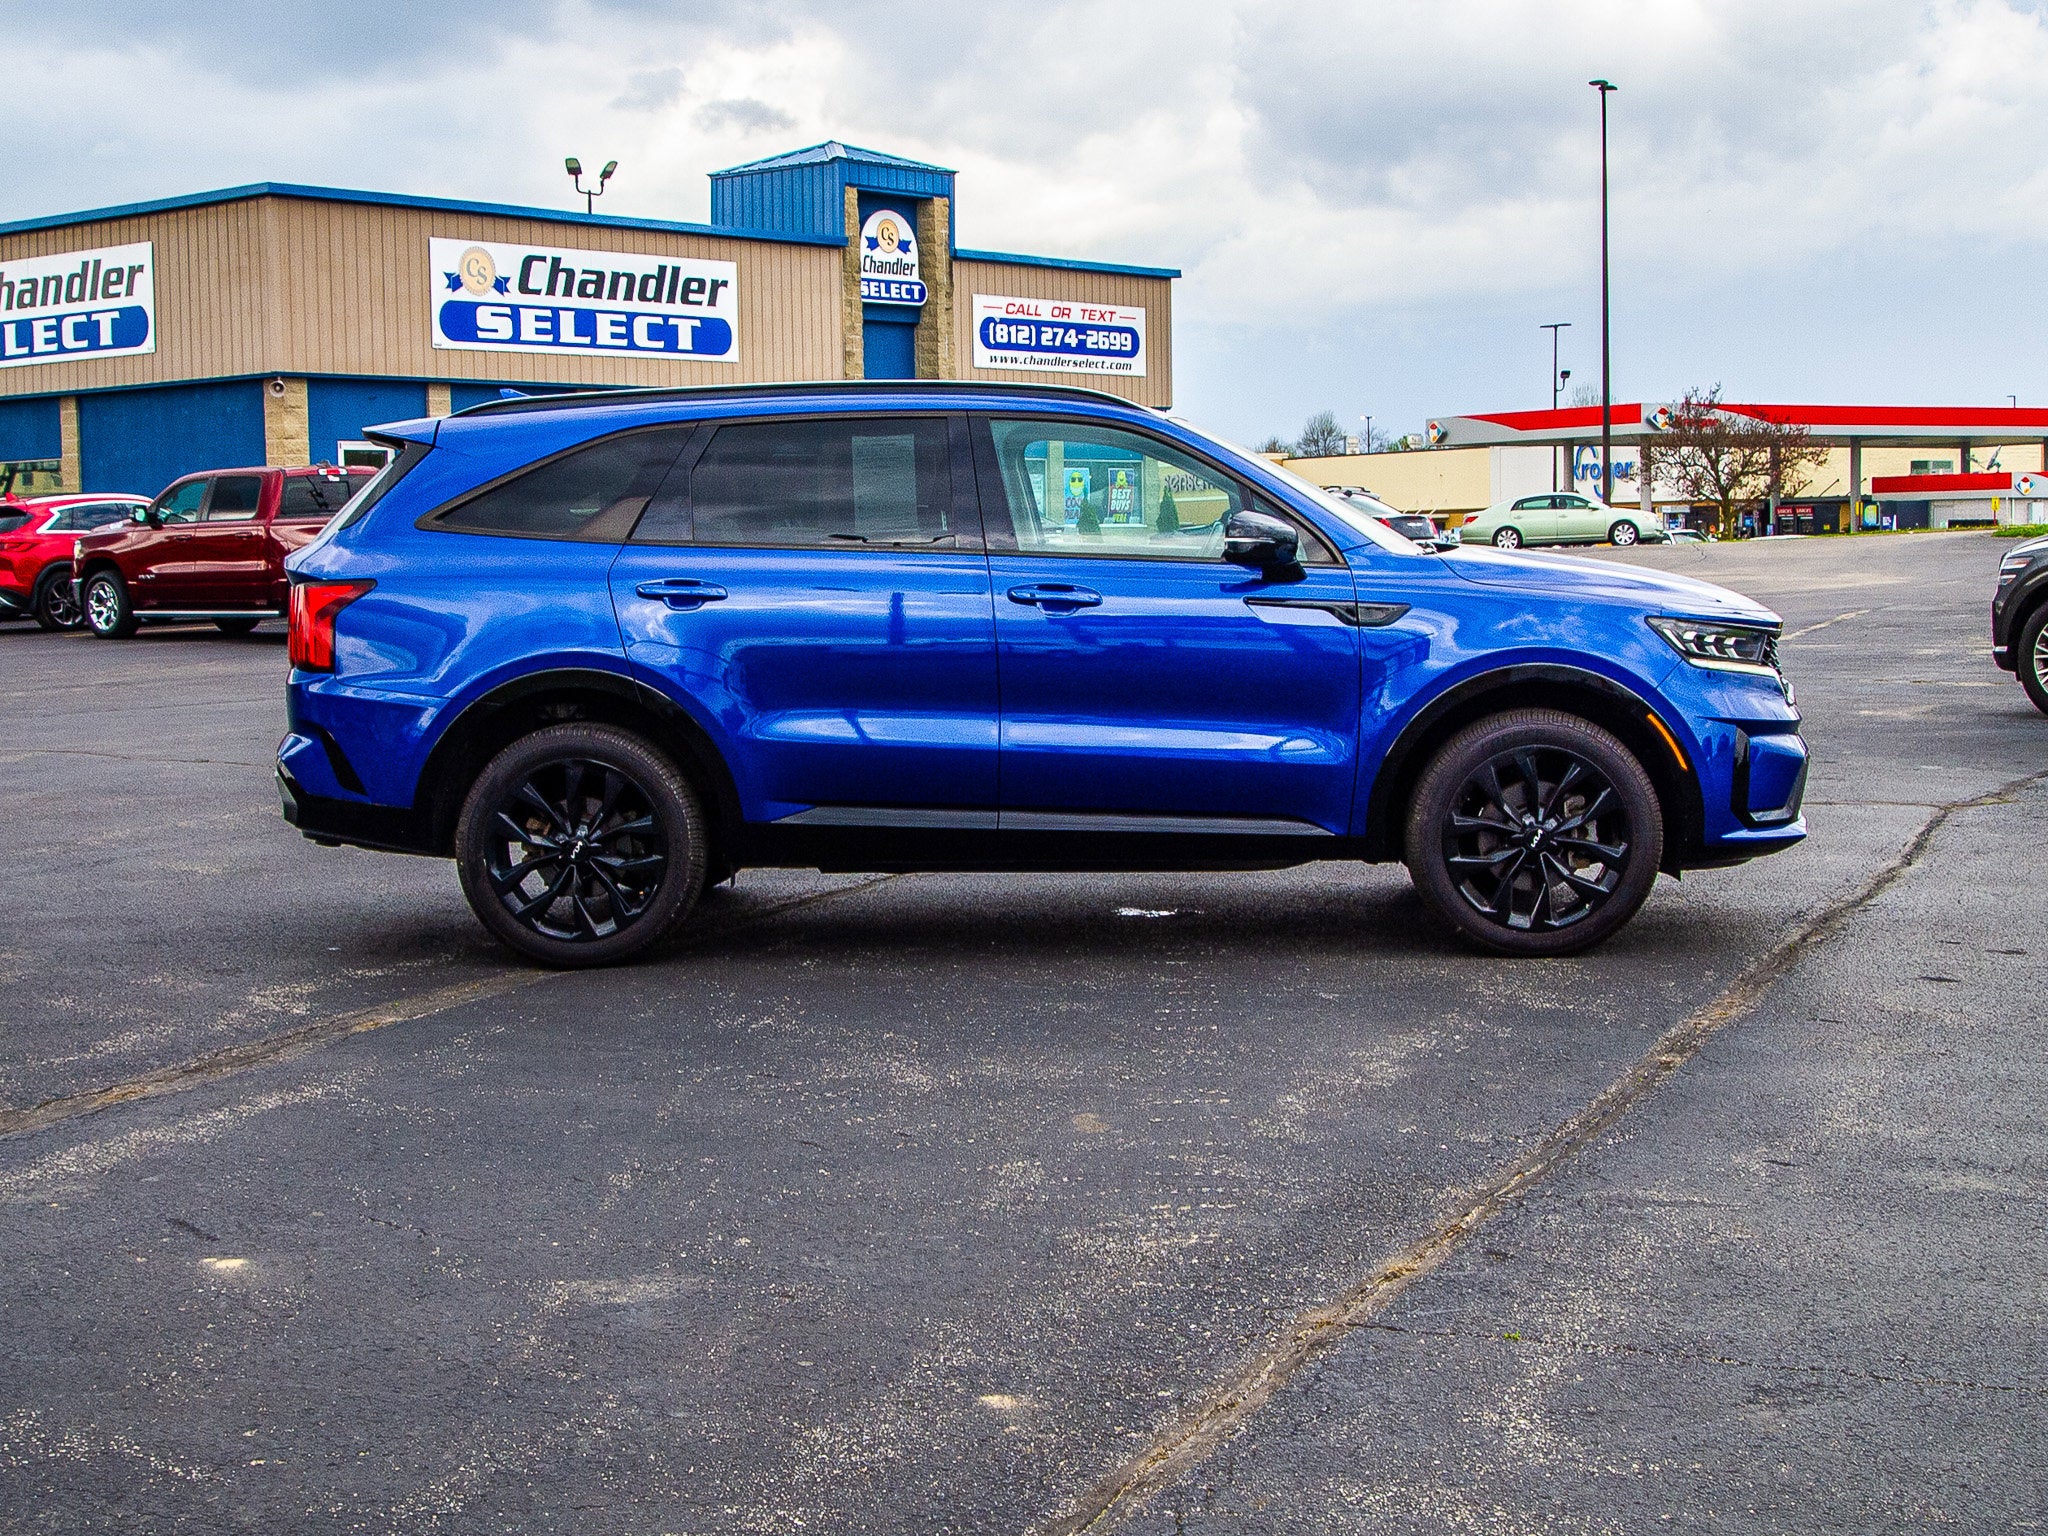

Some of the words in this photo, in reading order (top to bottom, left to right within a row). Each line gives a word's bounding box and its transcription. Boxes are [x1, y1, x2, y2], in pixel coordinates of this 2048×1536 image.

[863, 255, 916, 276] Chandler
[518, 254, 728, 307] Chandler
[861, 281, 921, 300] SELECT
[1005, 303, 1041, 317] CALL
[1051, 306, 1072, 320] OR
[1081, 309, 1117, 323] TEXT
[475, 305, 702, 351] SELECT
[989, 322, 1036, 346] (812)
[1041, 326, 1132, 352] 274-2699
[989, 354, 1132, 371] www.chandlerselect.com
[1111, 488, 1132, 500] BEST
[1110, 500, 1131, 511] BUYS
